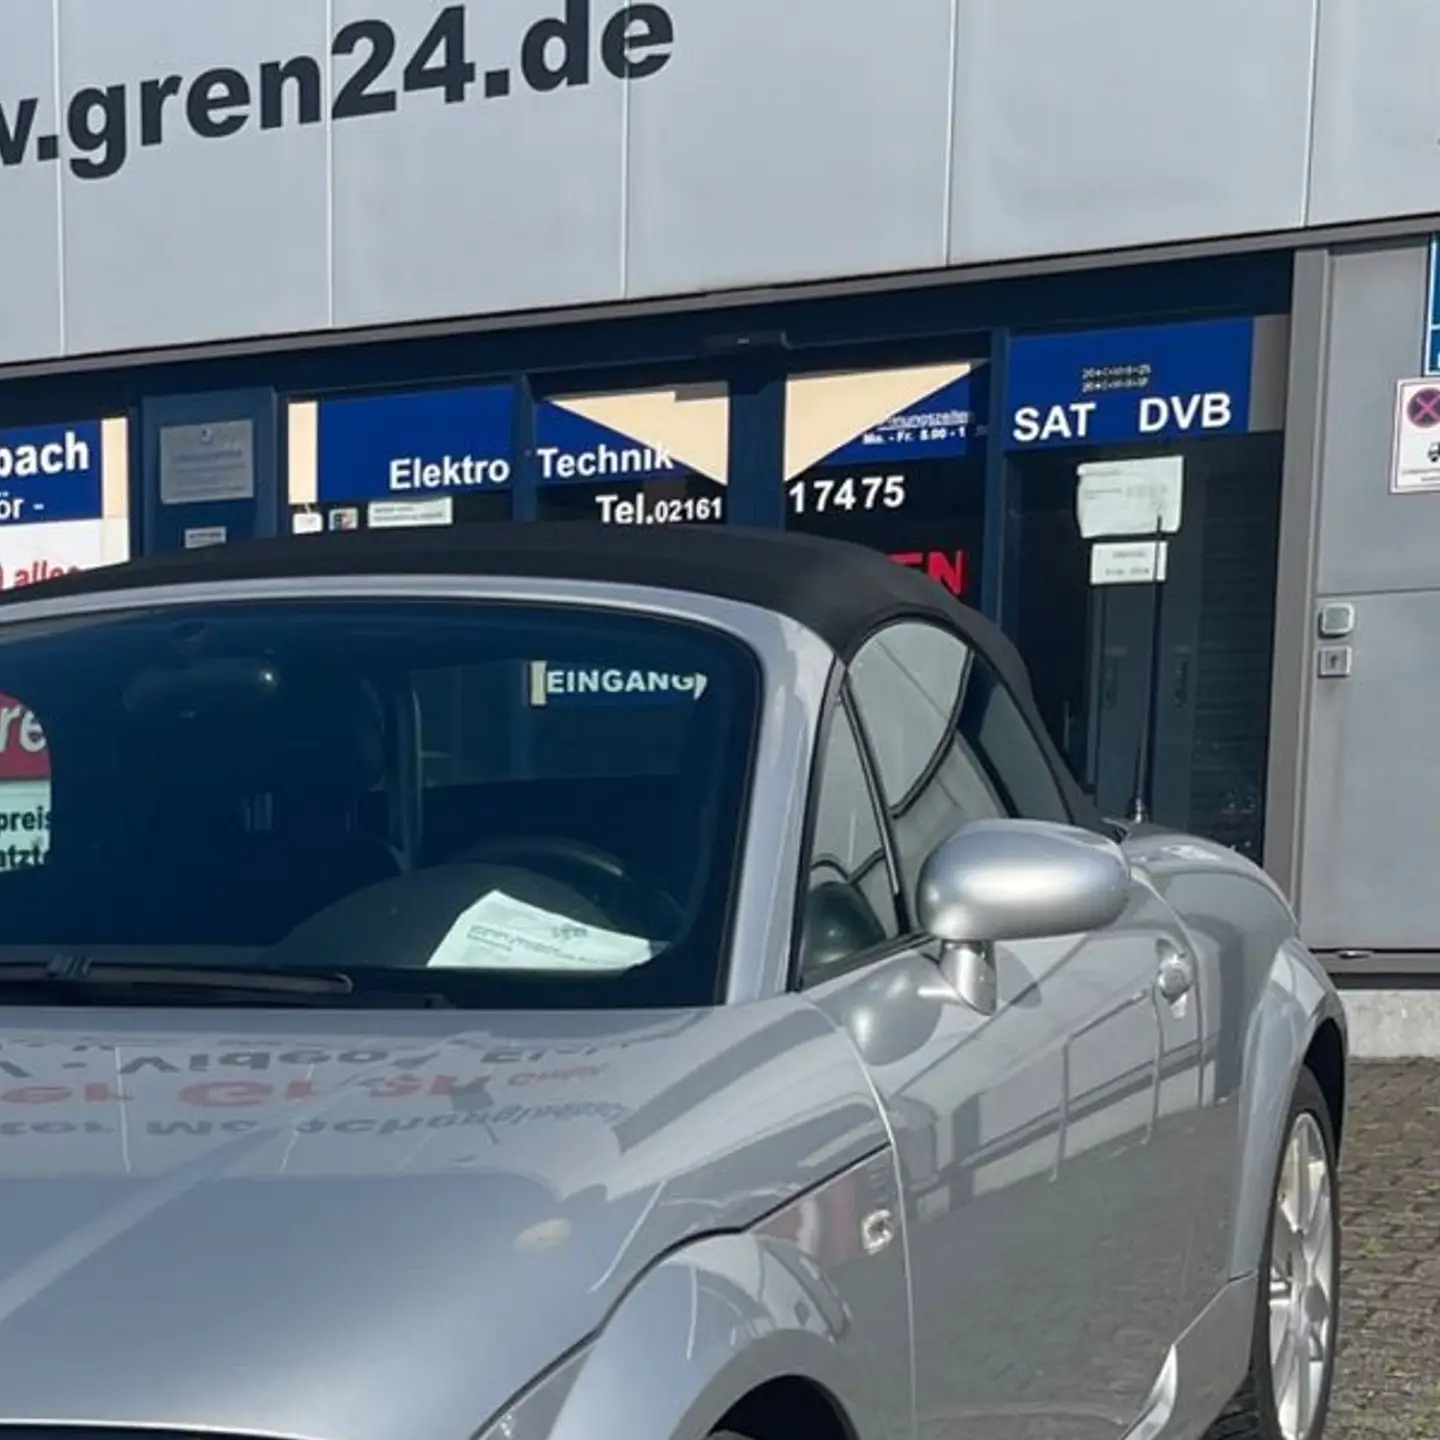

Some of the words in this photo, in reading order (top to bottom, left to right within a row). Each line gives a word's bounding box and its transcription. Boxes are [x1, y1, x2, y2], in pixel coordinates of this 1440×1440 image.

[1013, 401, 1096, 442] SAT
[1138, 391, 1232, 433] DVB
[389, 454, 510, 490] Elektro
[536, 444, 674, 479] Technik
[789, 475, 905, 514] 17475
[14, 561, 80, 588] alle
[547, 668, 695, 693] EINGANG
